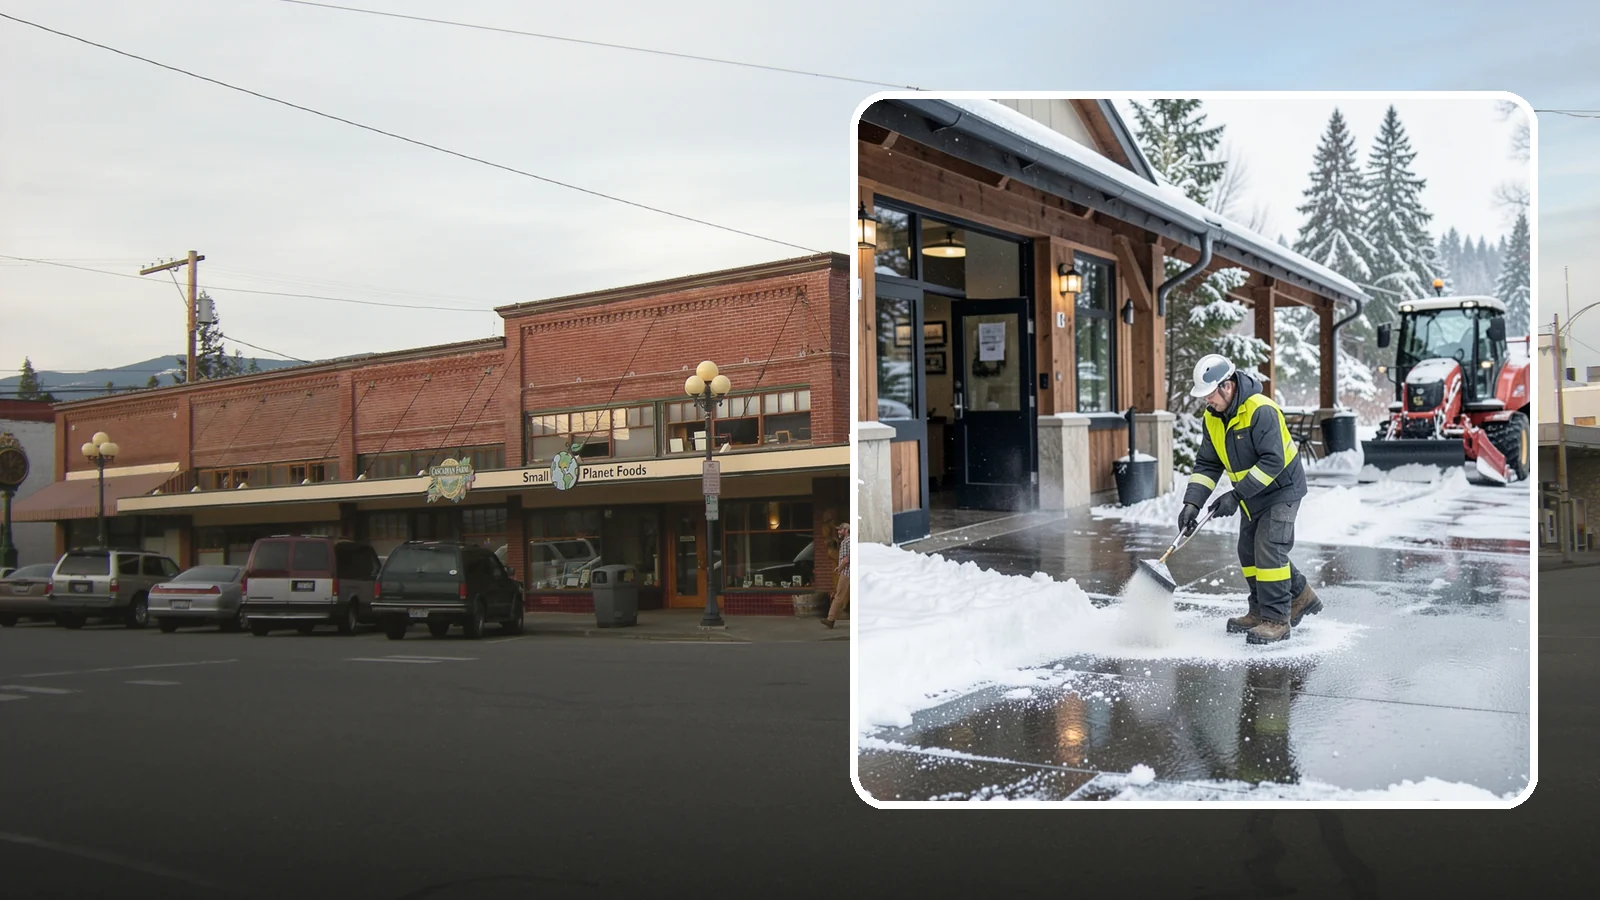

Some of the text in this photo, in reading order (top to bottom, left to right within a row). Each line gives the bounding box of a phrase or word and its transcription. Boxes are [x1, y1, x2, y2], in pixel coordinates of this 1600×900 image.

[523, 464, 647, 483] Small Planet Foods
